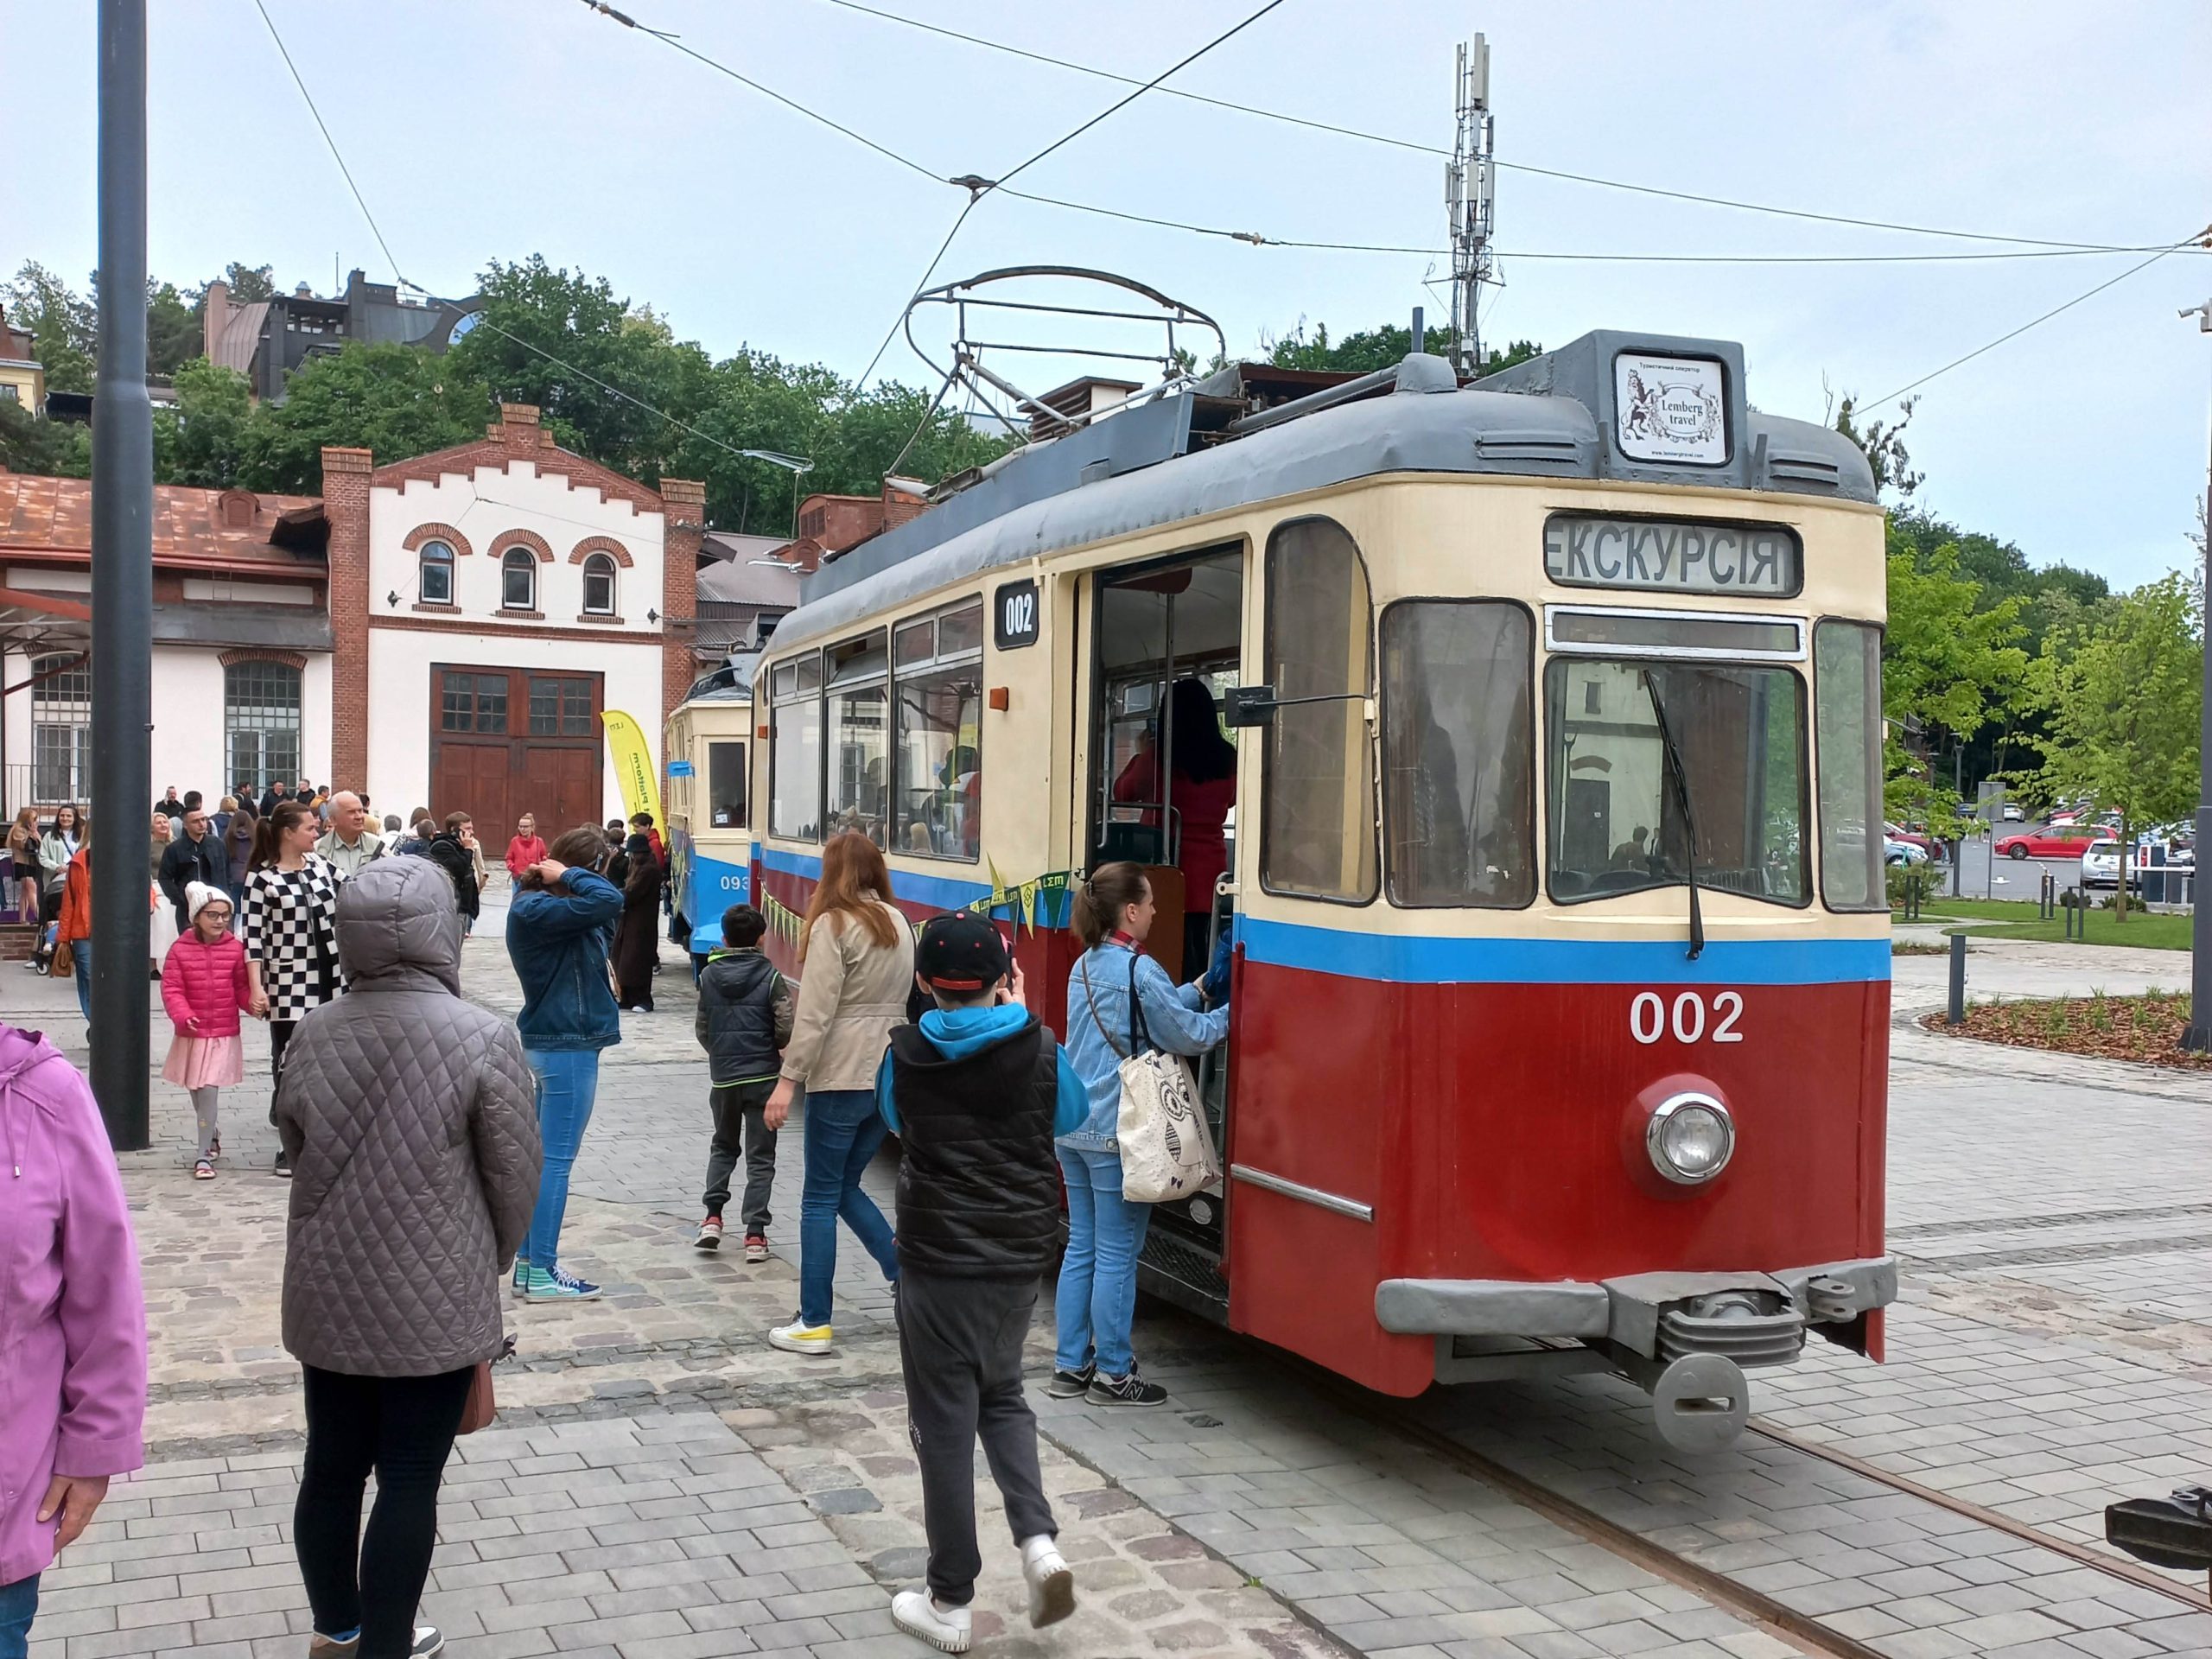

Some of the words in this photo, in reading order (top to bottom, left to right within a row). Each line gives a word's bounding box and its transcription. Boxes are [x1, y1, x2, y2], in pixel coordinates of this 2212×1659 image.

[1662, 399, 1703, 416] Lemberg
[1669, 414, 1696, 426] travel
[1546, 522, 1778, 586] ЕКСКУРСІЯ
[1005, 593, 1033, 636] 002
[1630, 990, 1744, 1045] 002
